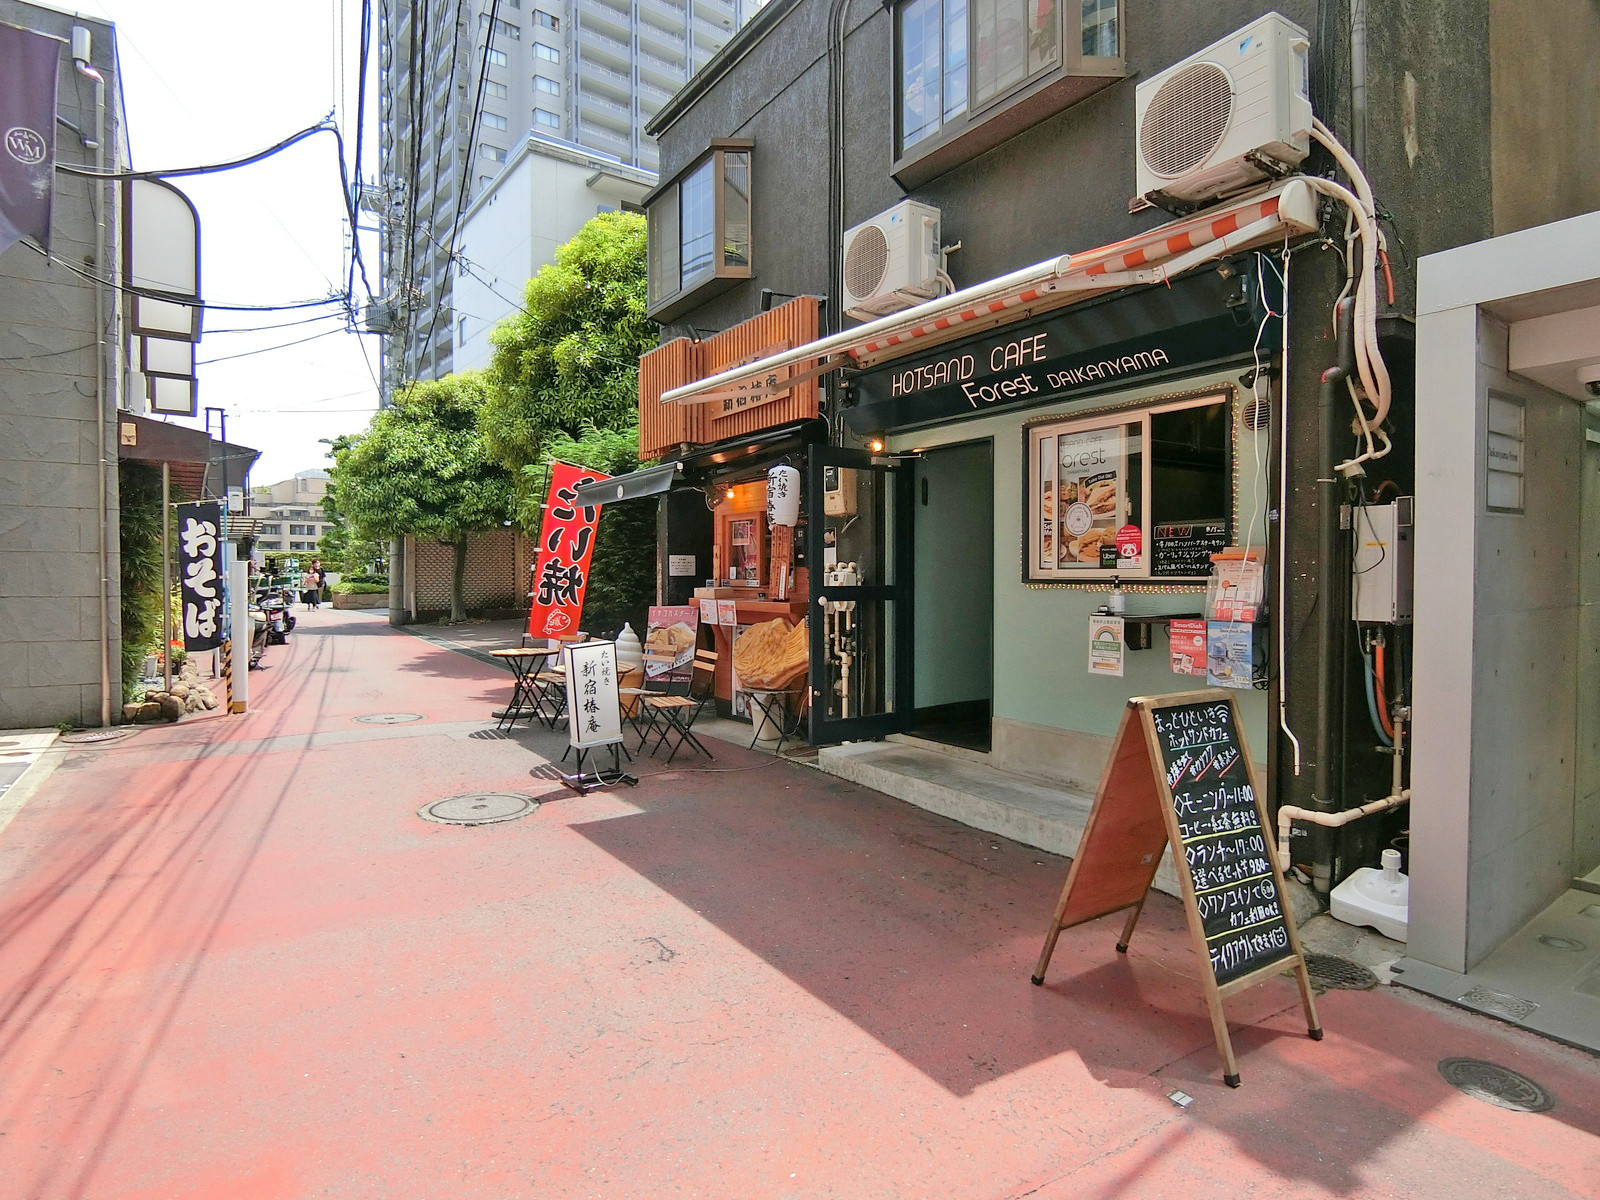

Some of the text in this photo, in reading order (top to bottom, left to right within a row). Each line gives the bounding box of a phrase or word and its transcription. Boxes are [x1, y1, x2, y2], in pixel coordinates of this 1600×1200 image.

[892, 333, 1047, 397] HOTSAND CAFE
[961, 349, 1169, 408] Forest DAIKANYAMA
[1061, 448, 1106, 468] orest
[1157, 526, 1191, 537] NEW
[181, 518, 221, 638] おそば
[601, 650, 611, 685] たい焼き
[581, 660, 601, 733] 新宿椿庵
[1169, 727, 1229, 748] ホットサンドカフェ
[1209, 931, 1276, 972] テイクアウトできます
